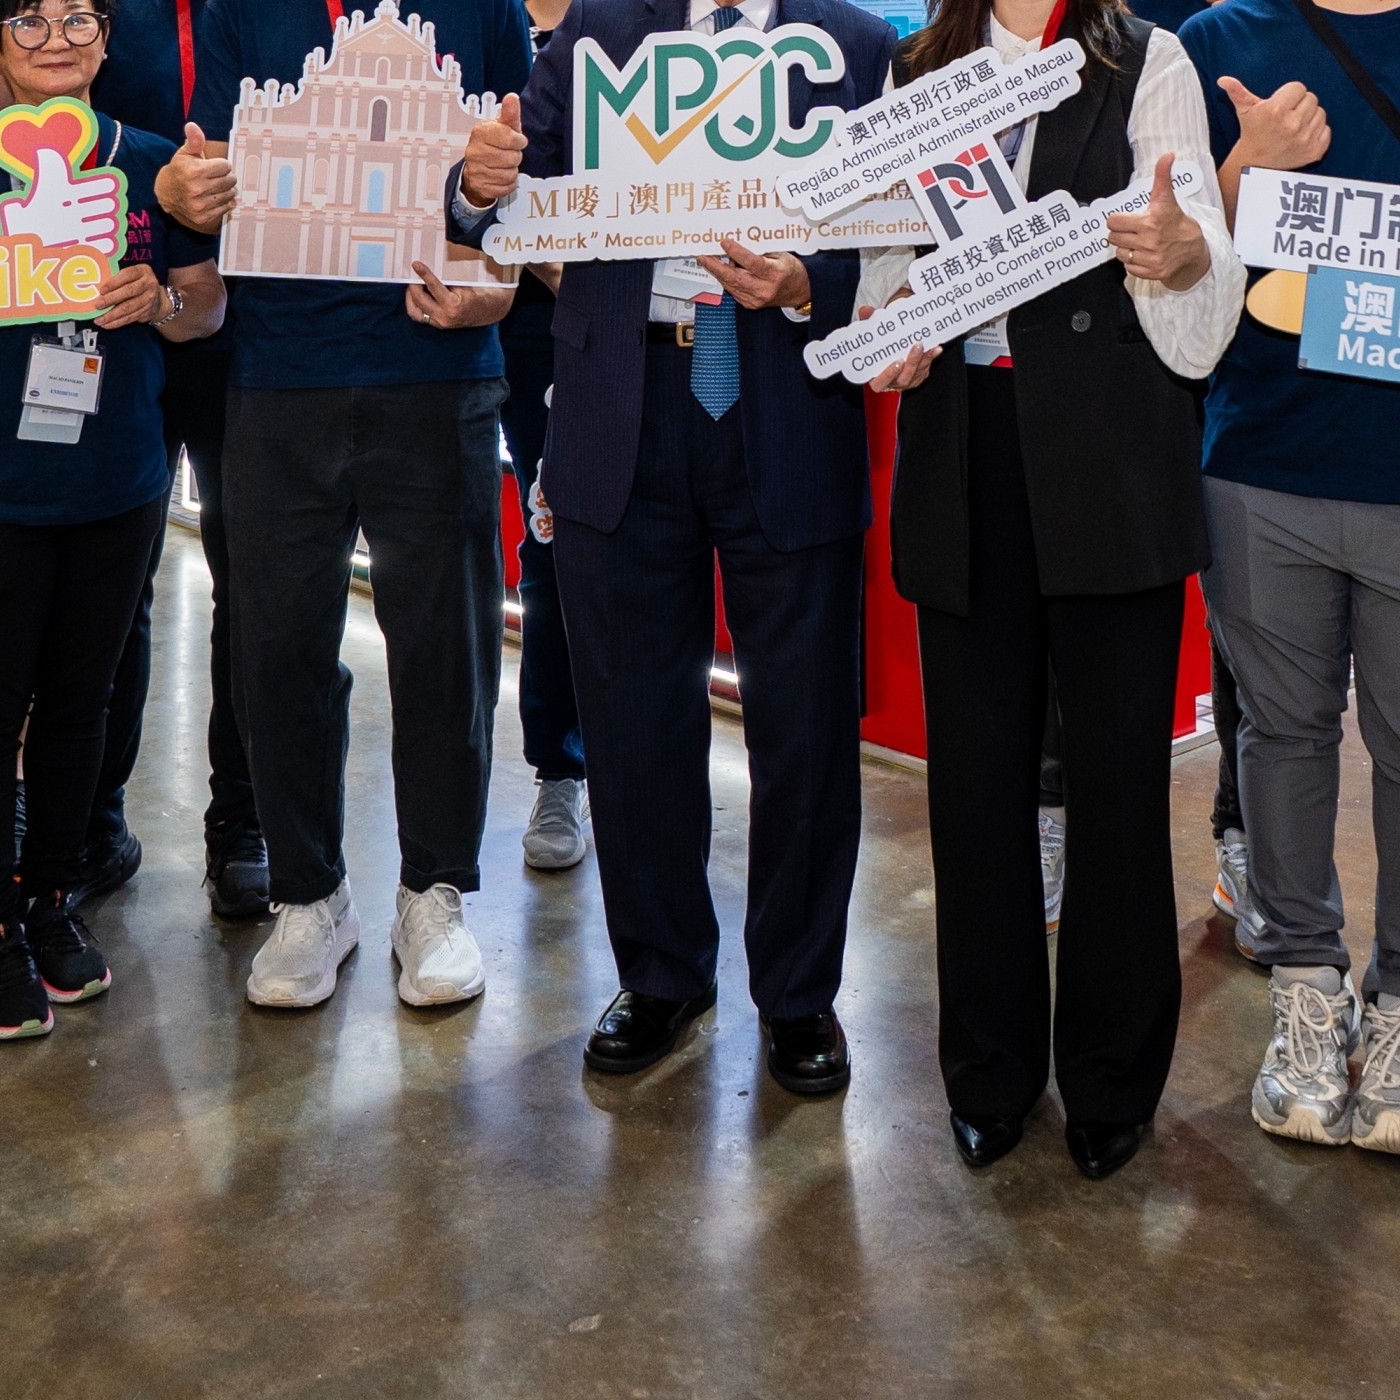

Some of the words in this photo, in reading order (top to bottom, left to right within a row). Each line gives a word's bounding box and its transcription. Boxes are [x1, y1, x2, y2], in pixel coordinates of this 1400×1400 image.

[787, 165, 840, 198] Região
[842, 117, 941, 172] Administrativa
[943, 84, 1003, 122] Especial
[1004, 74, 1024, 92] de
[1026, 50, 1075, 82] Macau
[810, 180, 860, 210] Macao
[862, 152, 916, 187] Special
[918, 102, 1016, 157] Administrative
[1018, 73, 1070, 107] Region
[846, 58, 997, 146] 澳門特別行政區
[605, 231, 666, 249] Macau
[671, 226, 742, 247] Product
[747, 222, 813, 245] Quality
[816, 216, 931, 238] Certification
[919, 202, 1072, 293] 招商投資促進局
[1273, 231, 1350, 264] Made
[1359, 248, 1385, 268] in
[815, 328, 875, 367] Instituto
[876, 318, 897, 338] de
[897, 280, 973, 327] Promoção
[975, 268, 995, 289] do
[996, 236, 1067, 278] Comércio
[1068, 230, 1079, 242] e
[1081, 215, 1101, 235] do
[851, 328, 934, 373] Commerce
[935, 309, 963, 333] and
[965, 272, 1043, 318] Investment
[1044, 239, 1110, 276] Promotio
